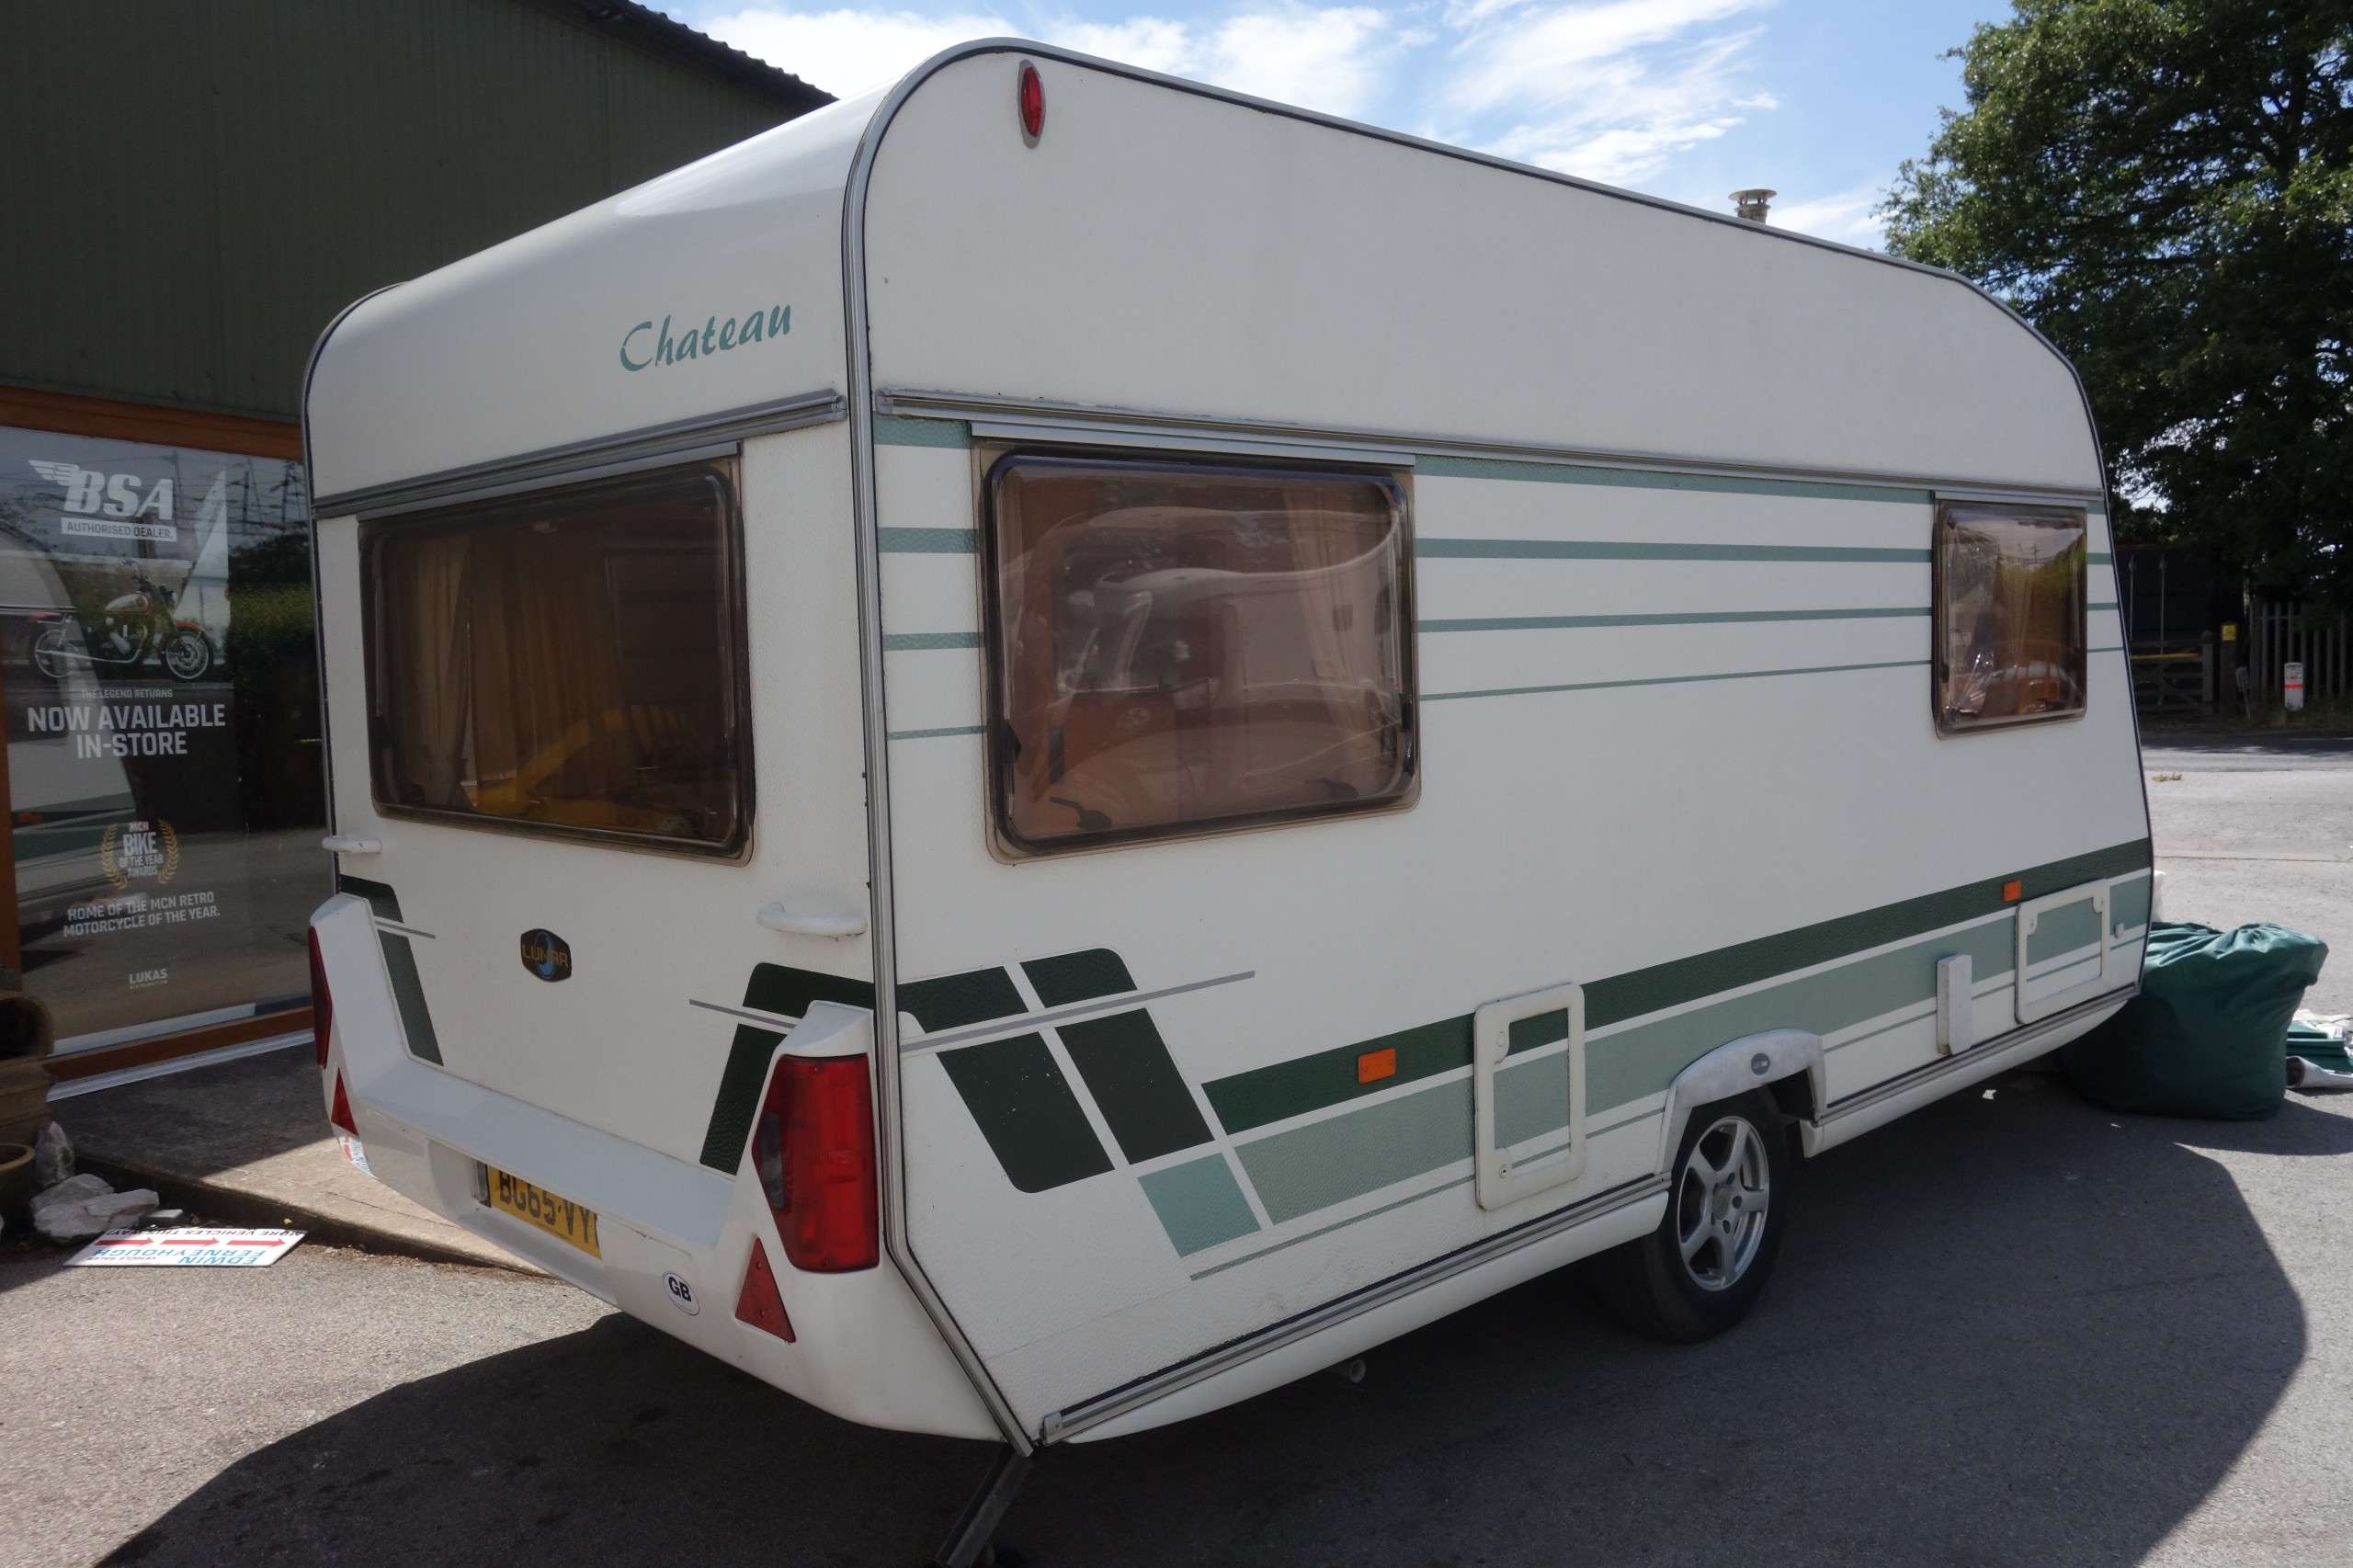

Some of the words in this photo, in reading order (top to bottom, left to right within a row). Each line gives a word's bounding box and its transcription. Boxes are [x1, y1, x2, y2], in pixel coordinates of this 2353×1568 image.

[620, 304, 791, 371] Chateau
[63, 470, 174, 520] BSA
[67, 521, 131, 536] AUTHORISED
[82, 689, 97, 699] THE
[99, 689, 133, 699] LEGEND
[135, 689, 173, 699] RETURNS
[27, 707, 90, 732] NOW
[98, 704, 226, 730] AVAILABLE
[76, 732, 188, 758] IN-STORE
[123, 832, 157, 857] BIKE
[131, 855, 144, 867] THE
[145, 854, 164, 865] YEAR
[67, 905, 104, 921] HOME
[107, 903, 123, 915] OF
[125, 900, 147, 914] THE
[151, 896, 176, 910] MCN
[179, 892, 214, 905] RETRO
[63, 915, 145, 937] MOTORCYCLE
[149, 913, 163, 926] OF
[165, 909, 186, 923] THE
[188, 905, 221, 919] YEAR.
[129, 969, 168, 984] LUKAS
[93, 1249, 266, 1257] FERNEYHOUGH
[178, 1256, 258, 1265] EDWIN
[668, 1276, 692, 1302] GB
